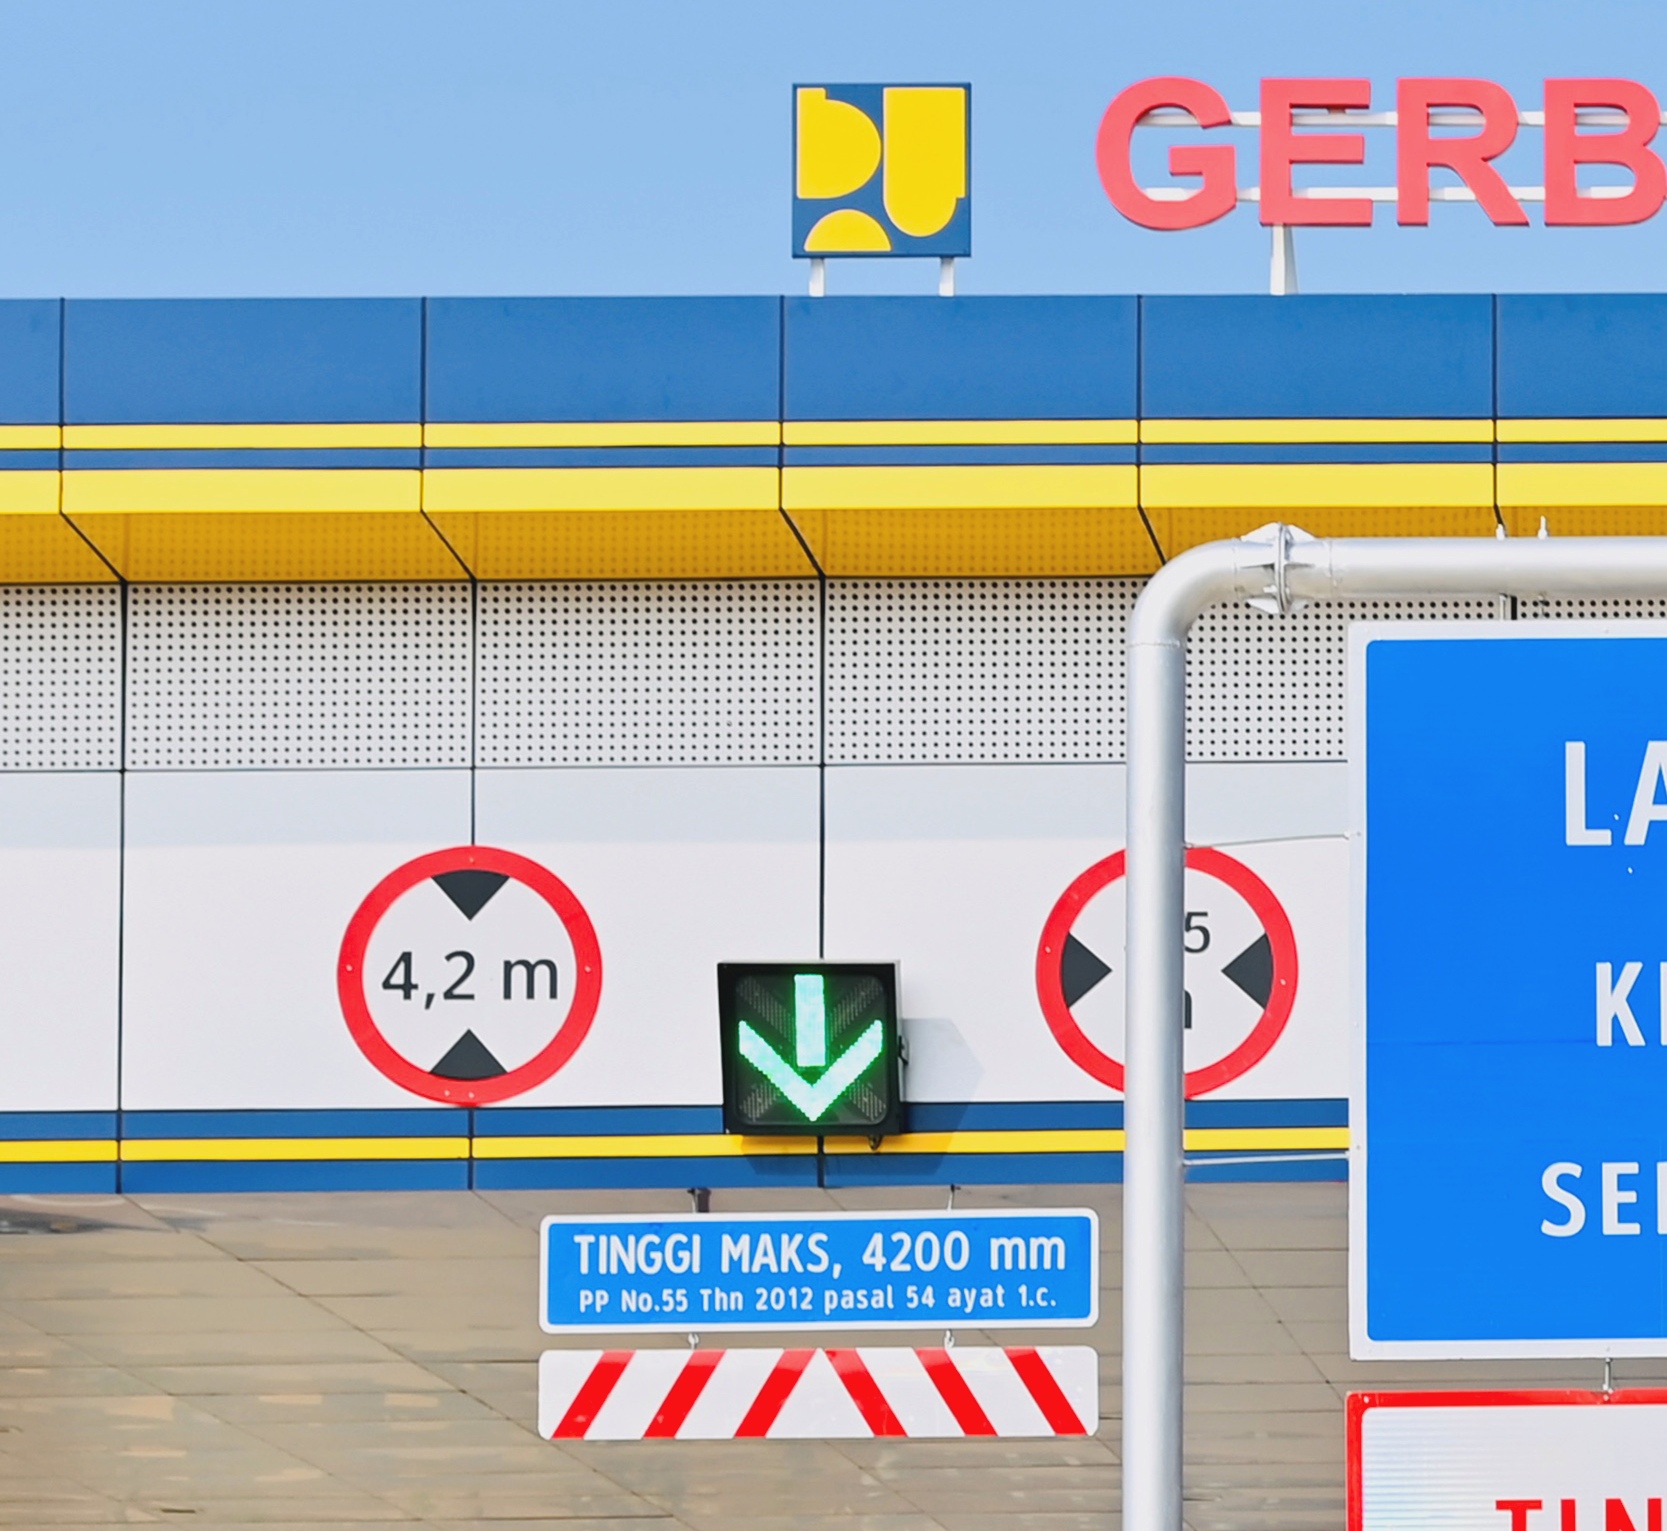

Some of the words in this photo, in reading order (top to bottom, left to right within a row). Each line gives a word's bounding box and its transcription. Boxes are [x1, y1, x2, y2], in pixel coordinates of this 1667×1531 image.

[381, 950, 475, 1010] 4,2
[503, 959, 558, 1000] m
[573, 1233, 701, 1275] TINGGI
[721, 1232, 842, 1279] MAKS,
[862, 1230, 970, 1272] 4200
[990, 1236, 1065, 1270] mm
[579, 1289, 609, 1313] PP
[621, 1288, 688, 1312] No.55
[700, 1287, 743, 1311] Thn
[755, 1287, 813, 1311] 2012
[824, 1286, 895, 1314] pasal
[907, 1285, 935, 1309] 54
[946, 1285, 1005, 1315] ayat
